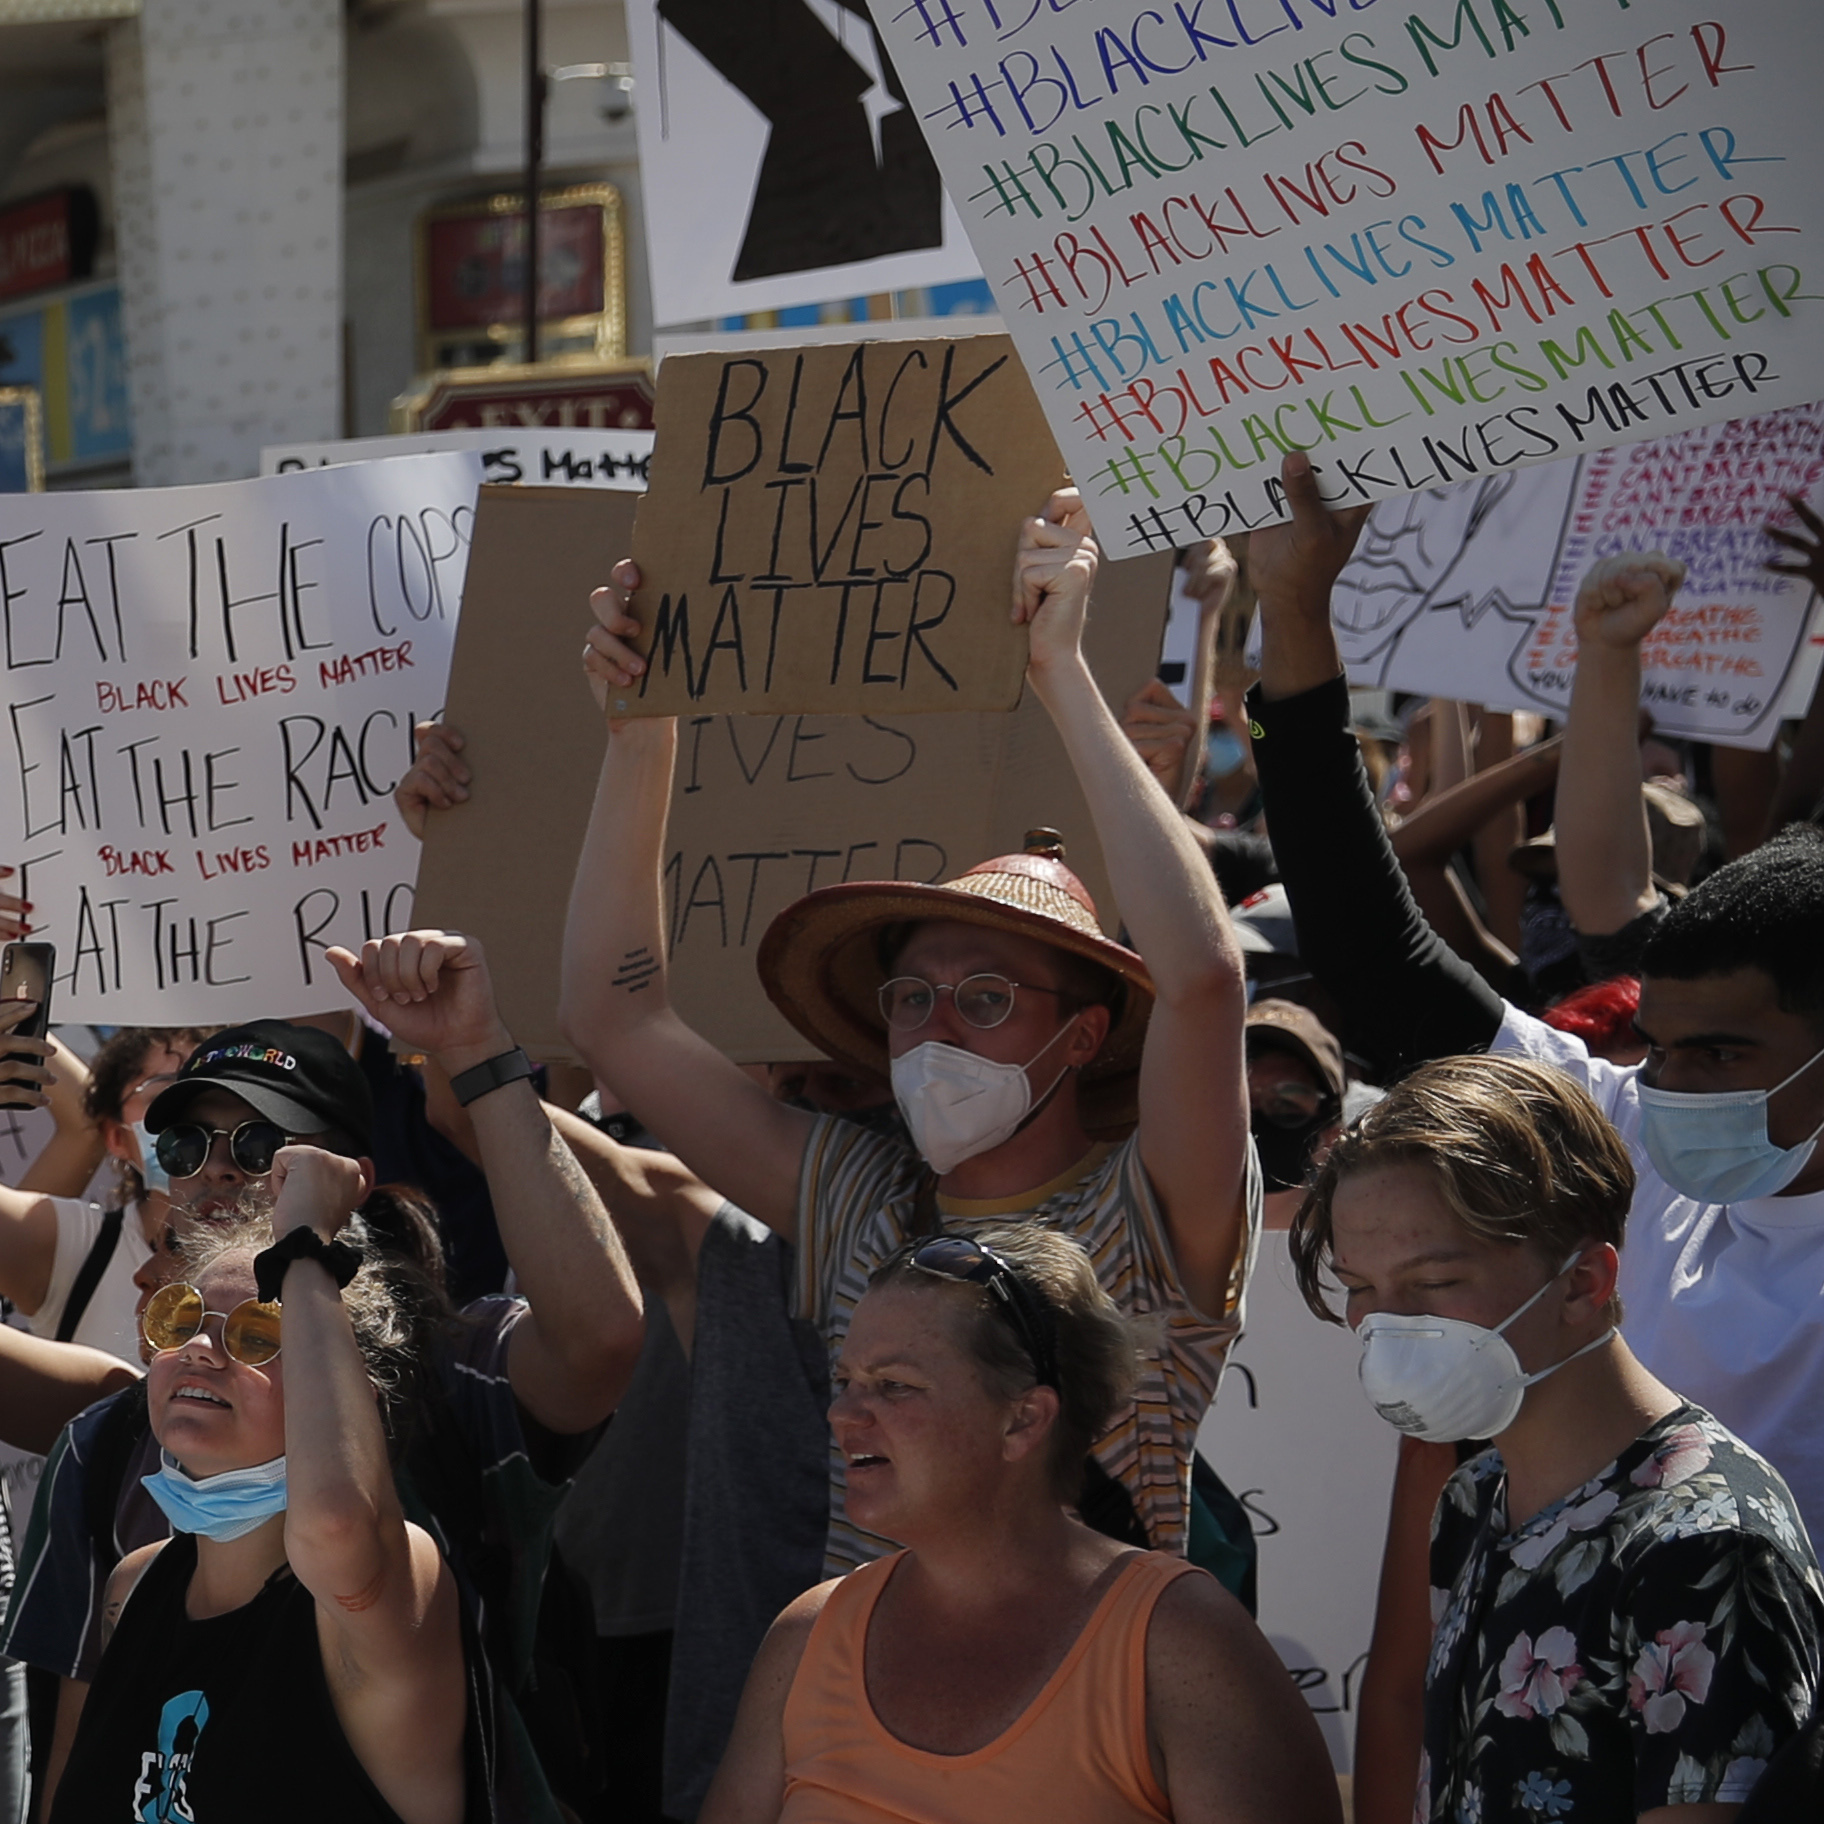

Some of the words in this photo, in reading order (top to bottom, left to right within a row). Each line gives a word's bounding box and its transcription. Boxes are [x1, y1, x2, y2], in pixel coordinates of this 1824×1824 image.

[1414, 21, 1755, 176] MATTER
[699, 345, 1008, 494] BLACK
[1713, 439, 1824, 459] BREATH
[708, 471, 933, 586] LIVES
[156, 512, 335, 664] THE
[638, 567, 958, 701] MATTER
[1661, 604, 1764, 627] REATHE
[1682, 578, 1794, 596] REATHE
[95, 674, 190, 715] BLACK
[214, 664, 298, 708] LIVES
[318, 640, 416, 687] MATTER
[9, 693, 106, 842] EAT
[116, 735, 255, 839] THE
[97, 844, 175, 878] BLACK
[196, 844, 271, 881] LIVES
[291, 822, 389, 868] MATTER
[140, 897, 252, 992] THE
